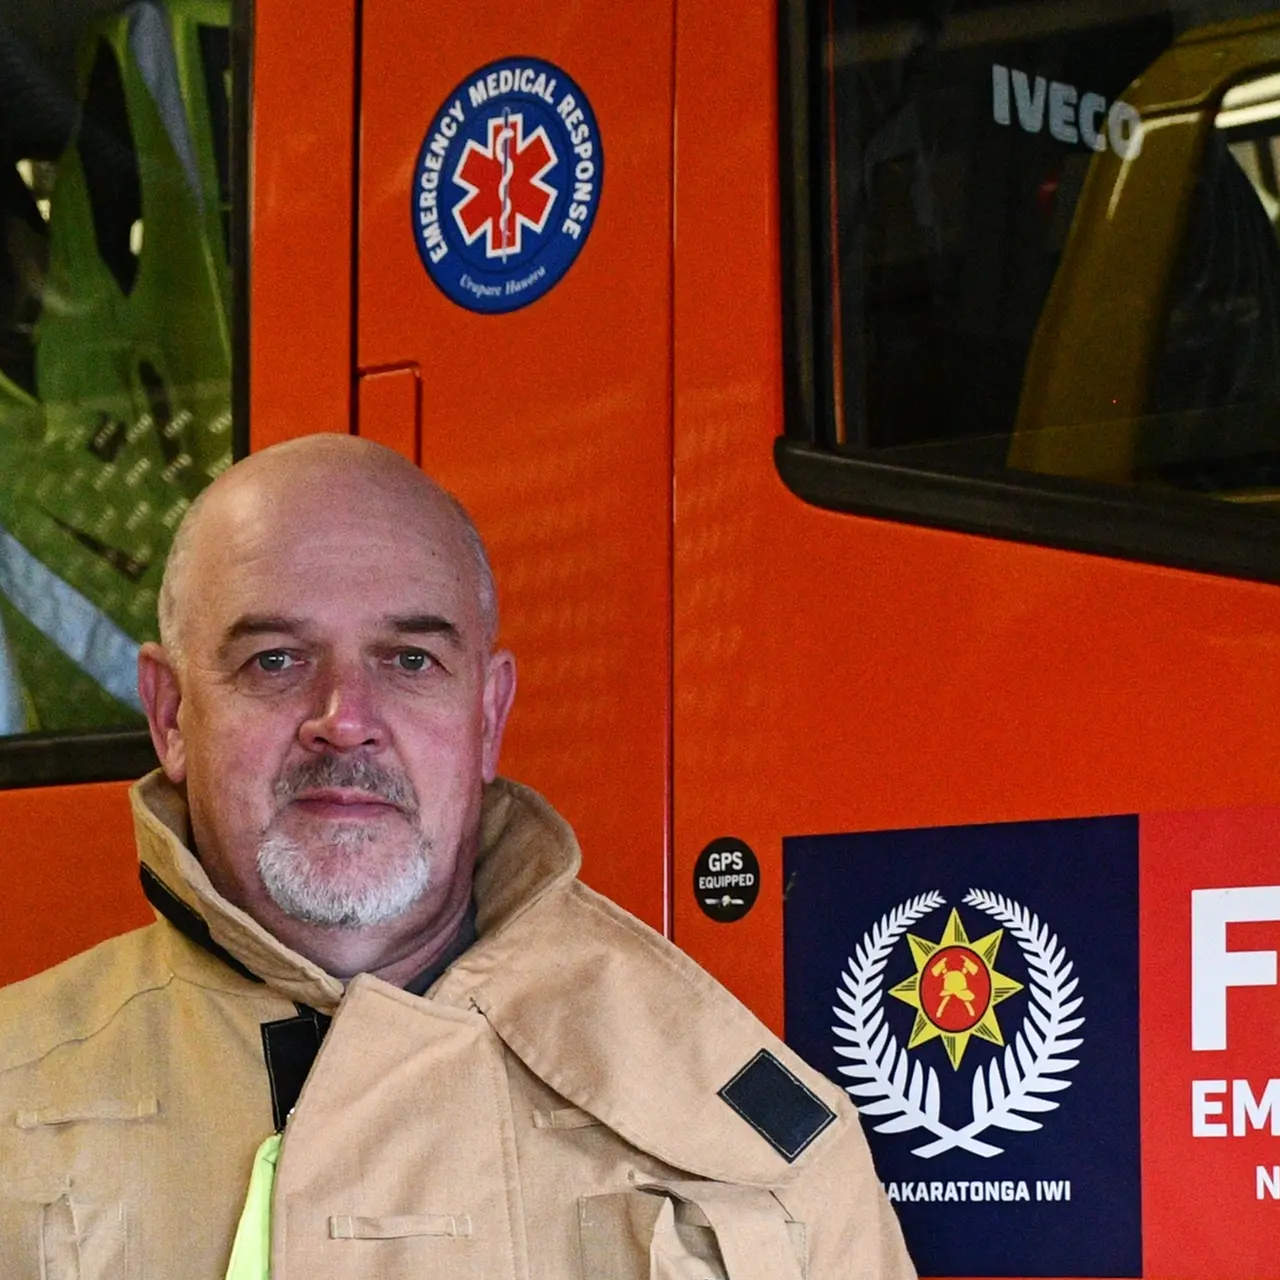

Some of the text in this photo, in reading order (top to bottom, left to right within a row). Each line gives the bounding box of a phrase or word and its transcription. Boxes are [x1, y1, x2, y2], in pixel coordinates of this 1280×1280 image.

[992, 64, 1144, 161] IVECO
[419, 68, 595, 264] EMERGENCY MEDICAL RESPONSE
[708, 851, 743, 872] GPS
[699, 873, 755, 890] EQUIPPED
[881, 1180, 1072, 1203] AKARATONGA IWI
